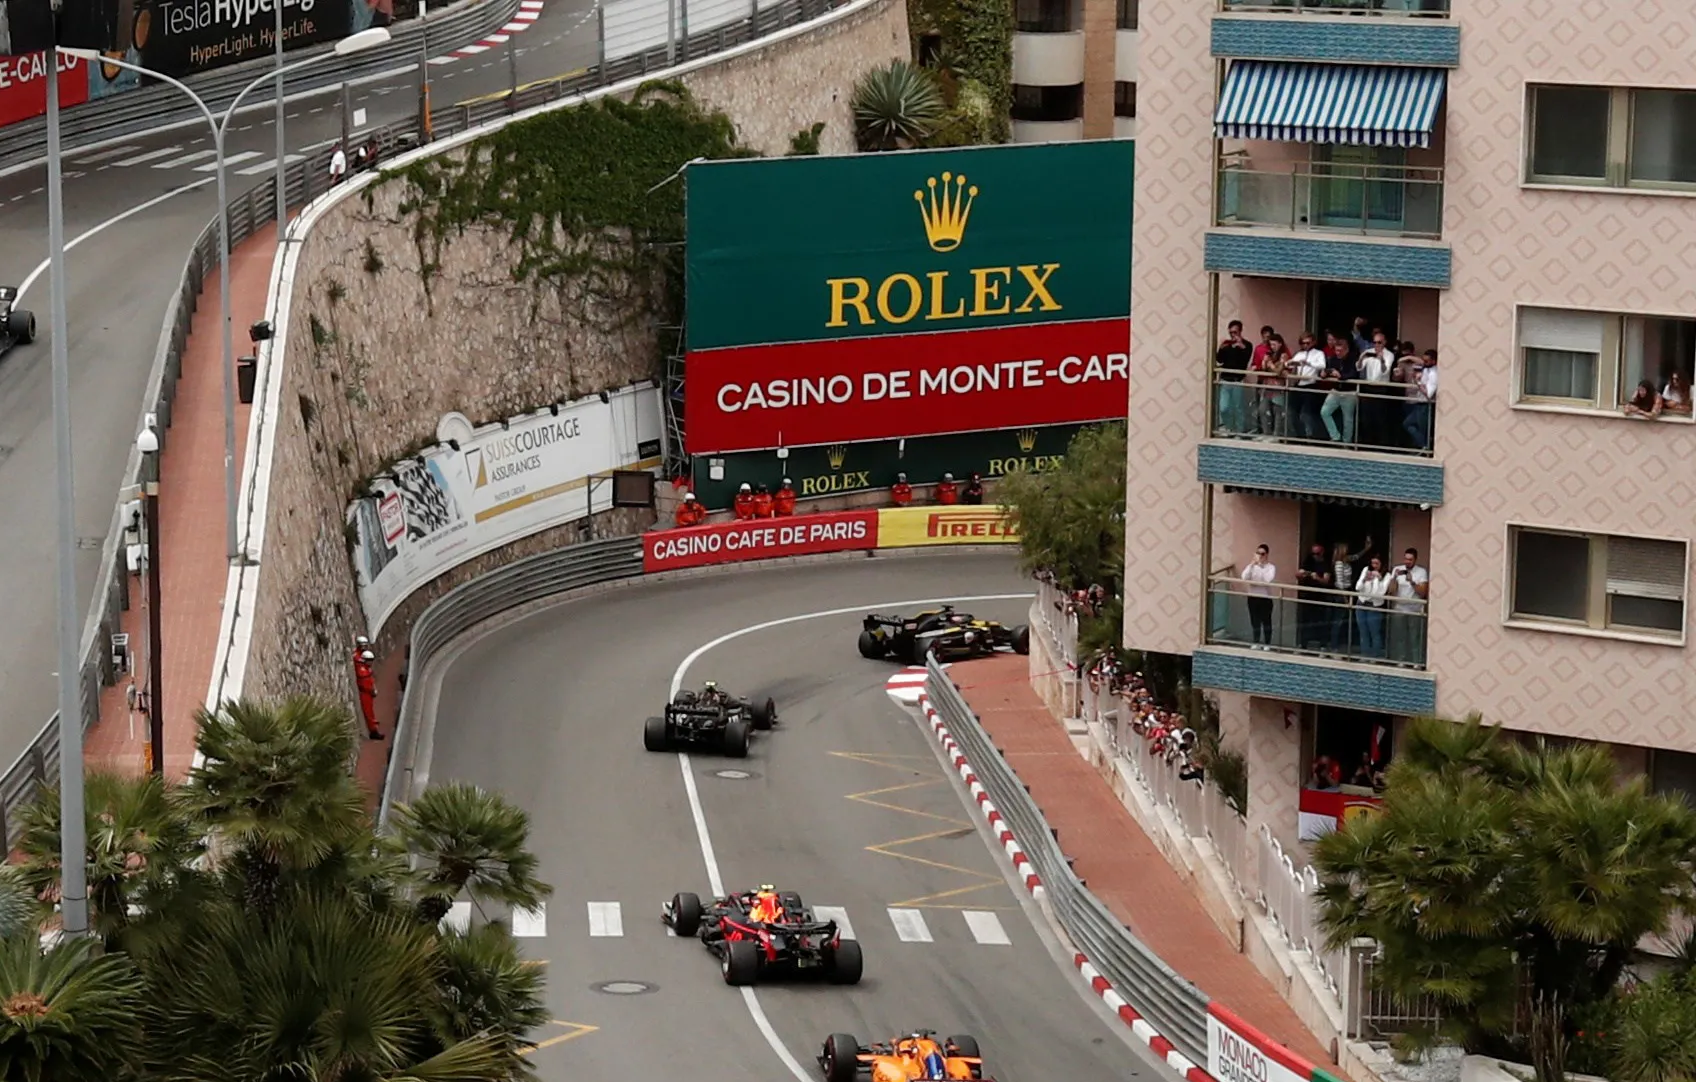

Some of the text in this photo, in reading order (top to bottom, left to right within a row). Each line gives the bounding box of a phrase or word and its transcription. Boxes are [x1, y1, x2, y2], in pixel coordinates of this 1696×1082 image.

[159, 0, 212, 36] Tesla
[190, 18, 317, 63] HyperLight. HyerLife.
[824, 263, 1063, 328] ROLEX
[716, 352, 1128, 414] CASINO DE MONTE-CAR
[491, 454, 541, 484] ASSURANCES
[803, 471, 870, 496] ROLEX
[988, 455, 1065, 477] ROLEX
[654, 520, 866, 560] CASINO CAFE DE PARIS
[927, 513, 1019, 538] PIRELL
